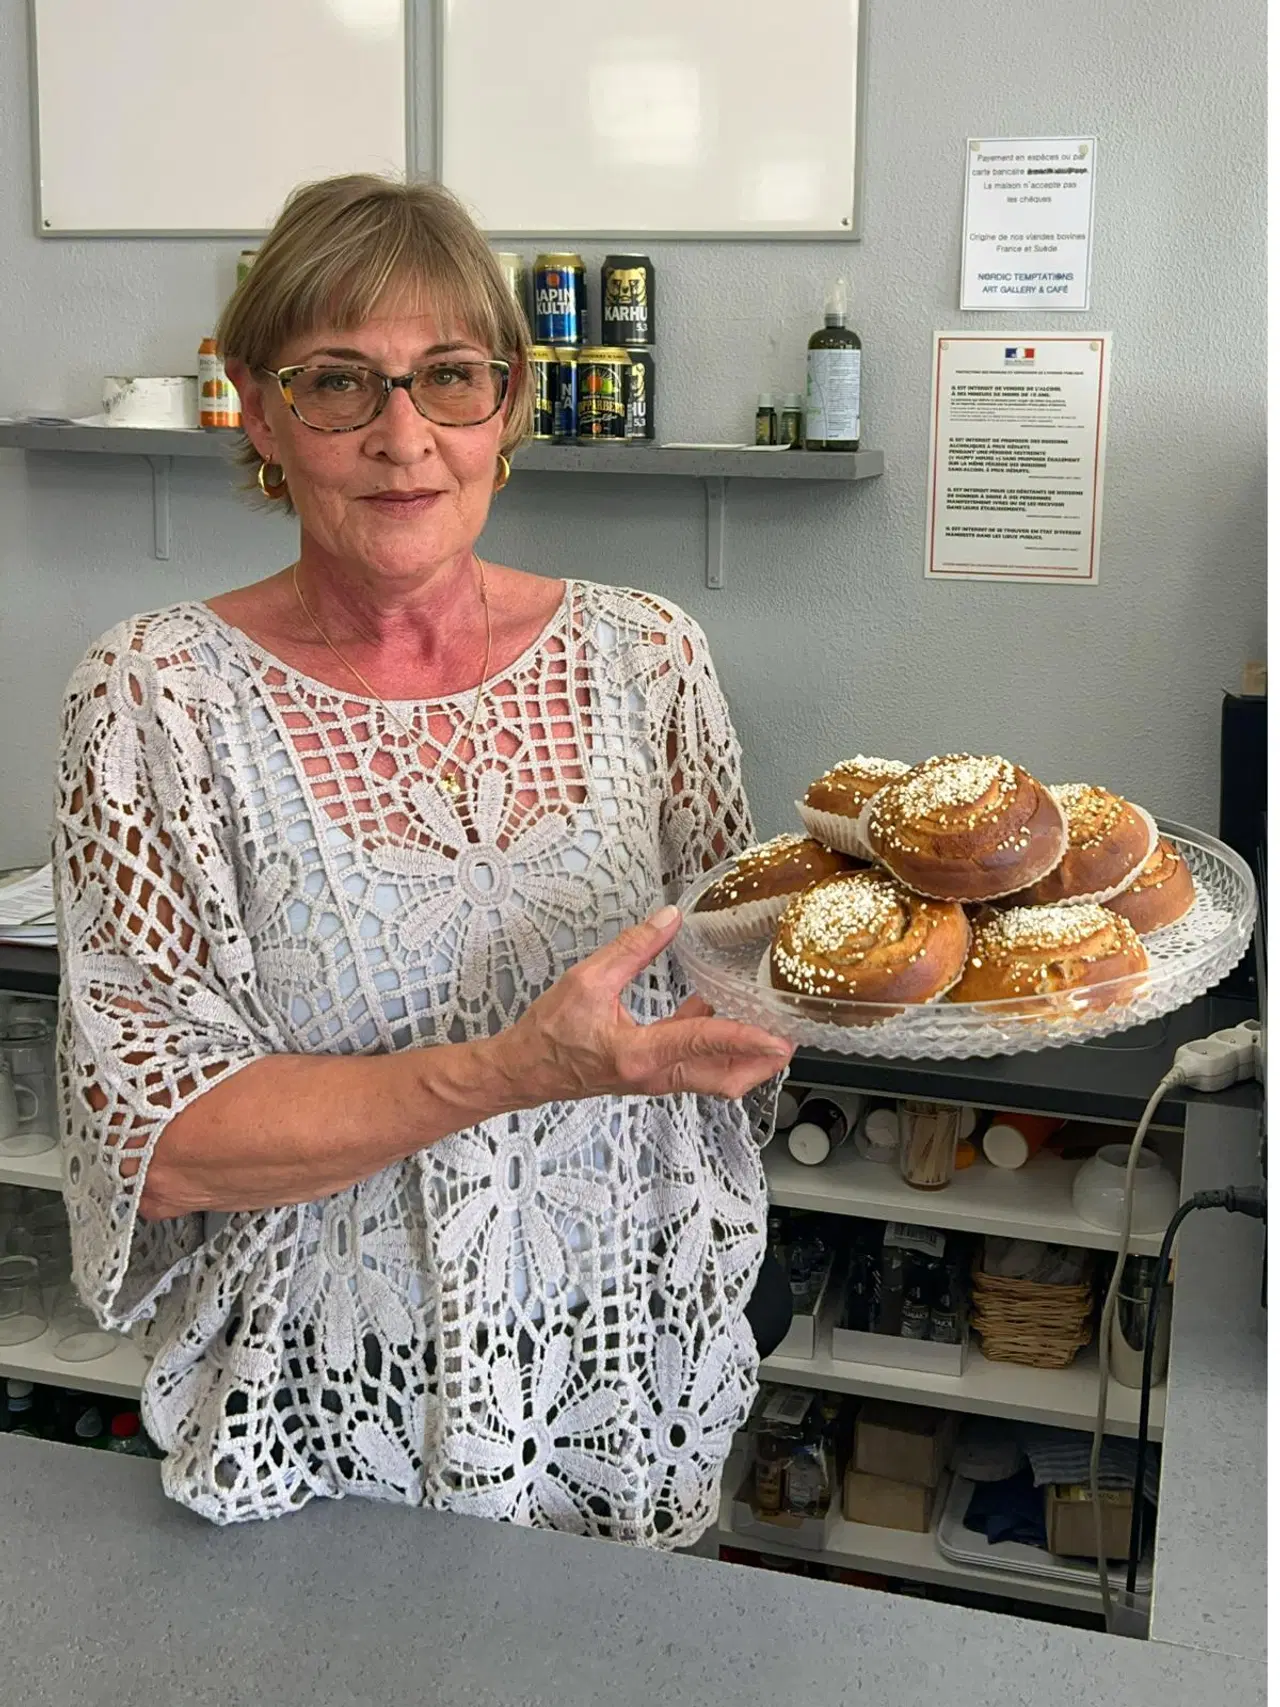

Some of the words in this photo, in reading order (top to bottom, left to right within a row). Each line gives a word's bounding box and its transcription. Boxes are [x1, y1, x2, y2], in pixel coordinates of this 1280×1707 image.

[978, 273, 1012, 281] NORDIC
[1014, 273, 1074, 281] TEMPTATIONS
[537, 289, 575, 301] LAPIN
[982, 285, 997, 293] ART
[1000, 285, 1036, 293] GALLERY
[537, 302, 576, 315] KULTA
[605, 306, 648, 321] KARHU
